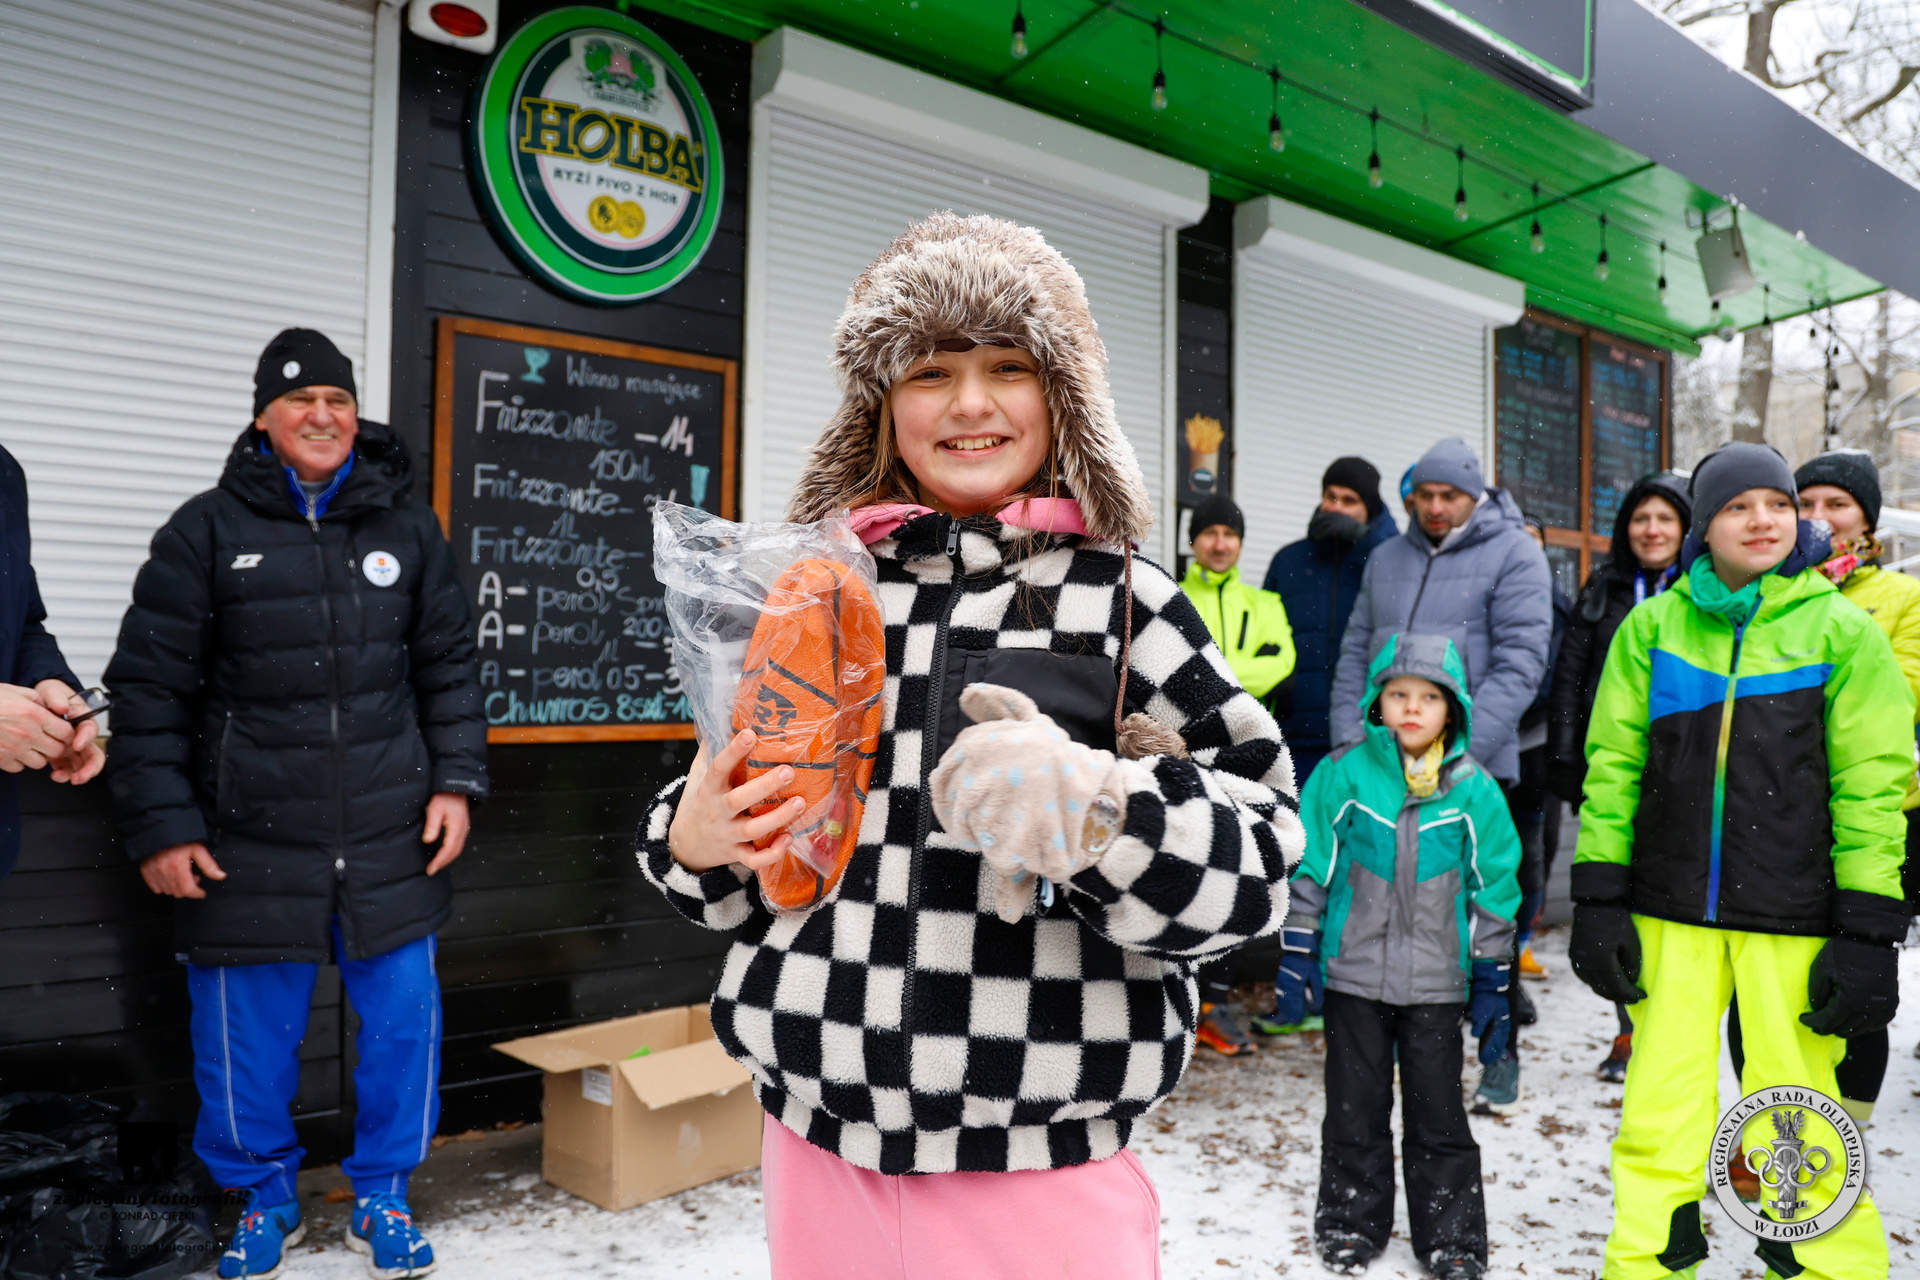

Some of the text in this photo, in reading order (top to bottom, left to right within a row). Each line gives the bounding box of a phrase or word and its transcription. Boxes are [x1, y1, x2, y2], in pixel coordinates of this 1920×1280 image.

[519, 96, 703, 194] HOLBA
[597, 175, 632, 194] PIVO
[637, 184, 646, 198] Z
[649, 187, 679, 205] HOR
[485, 689, 610, 724] Churros
